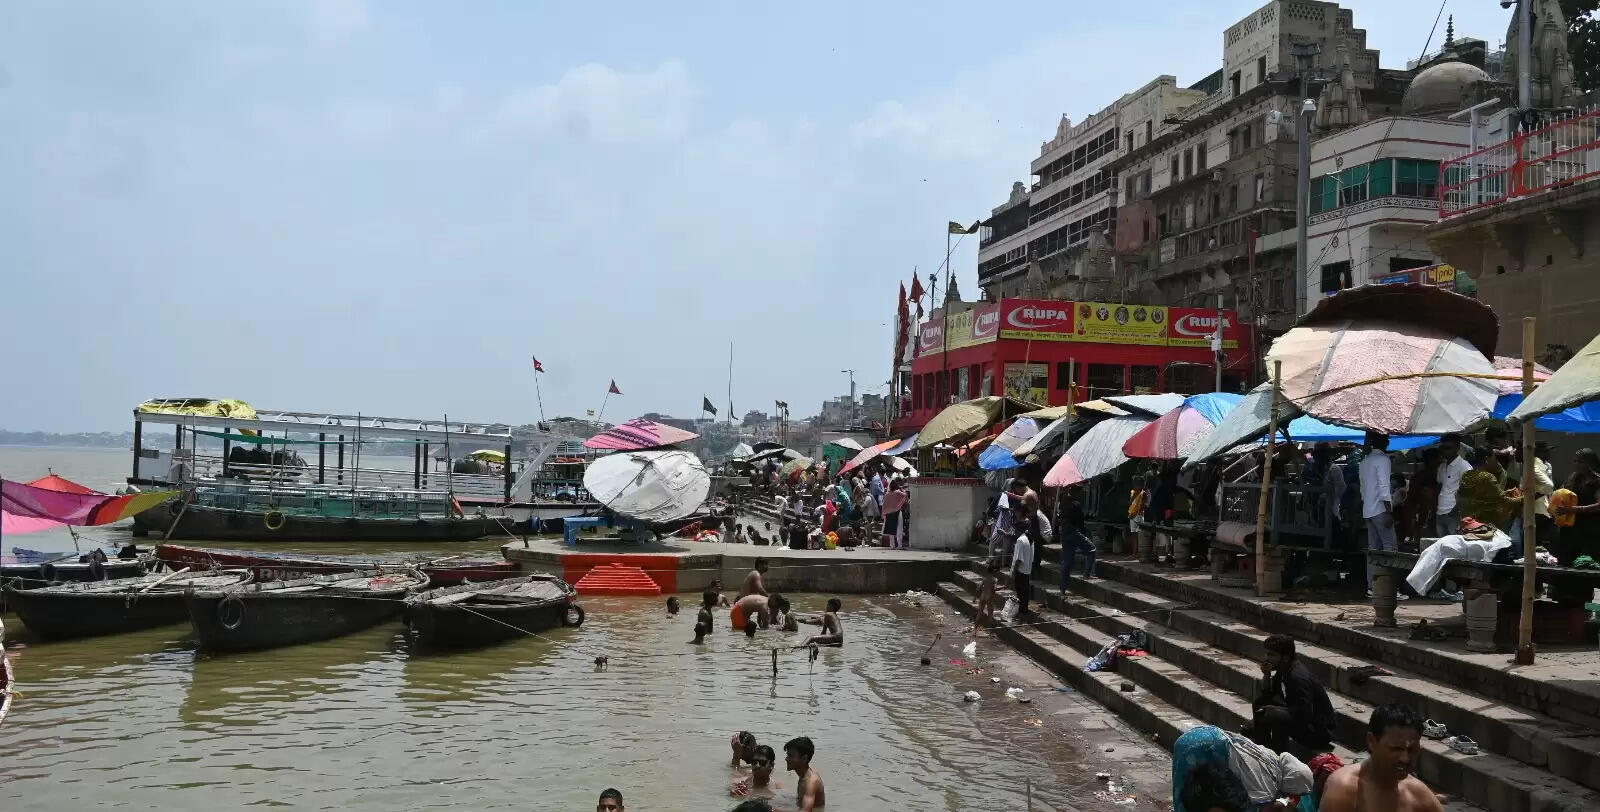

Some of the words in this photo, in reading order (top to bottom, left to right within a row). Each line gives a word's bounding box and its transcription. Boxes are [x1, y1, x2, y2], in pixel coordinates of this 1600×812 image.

[1438, 268, 1453, 281] pnb
[981, 311, 999, 325] RUPA
[1023, 308, 1067, 320] RUPA
[1189, 316, 1231, 328] RUPA
